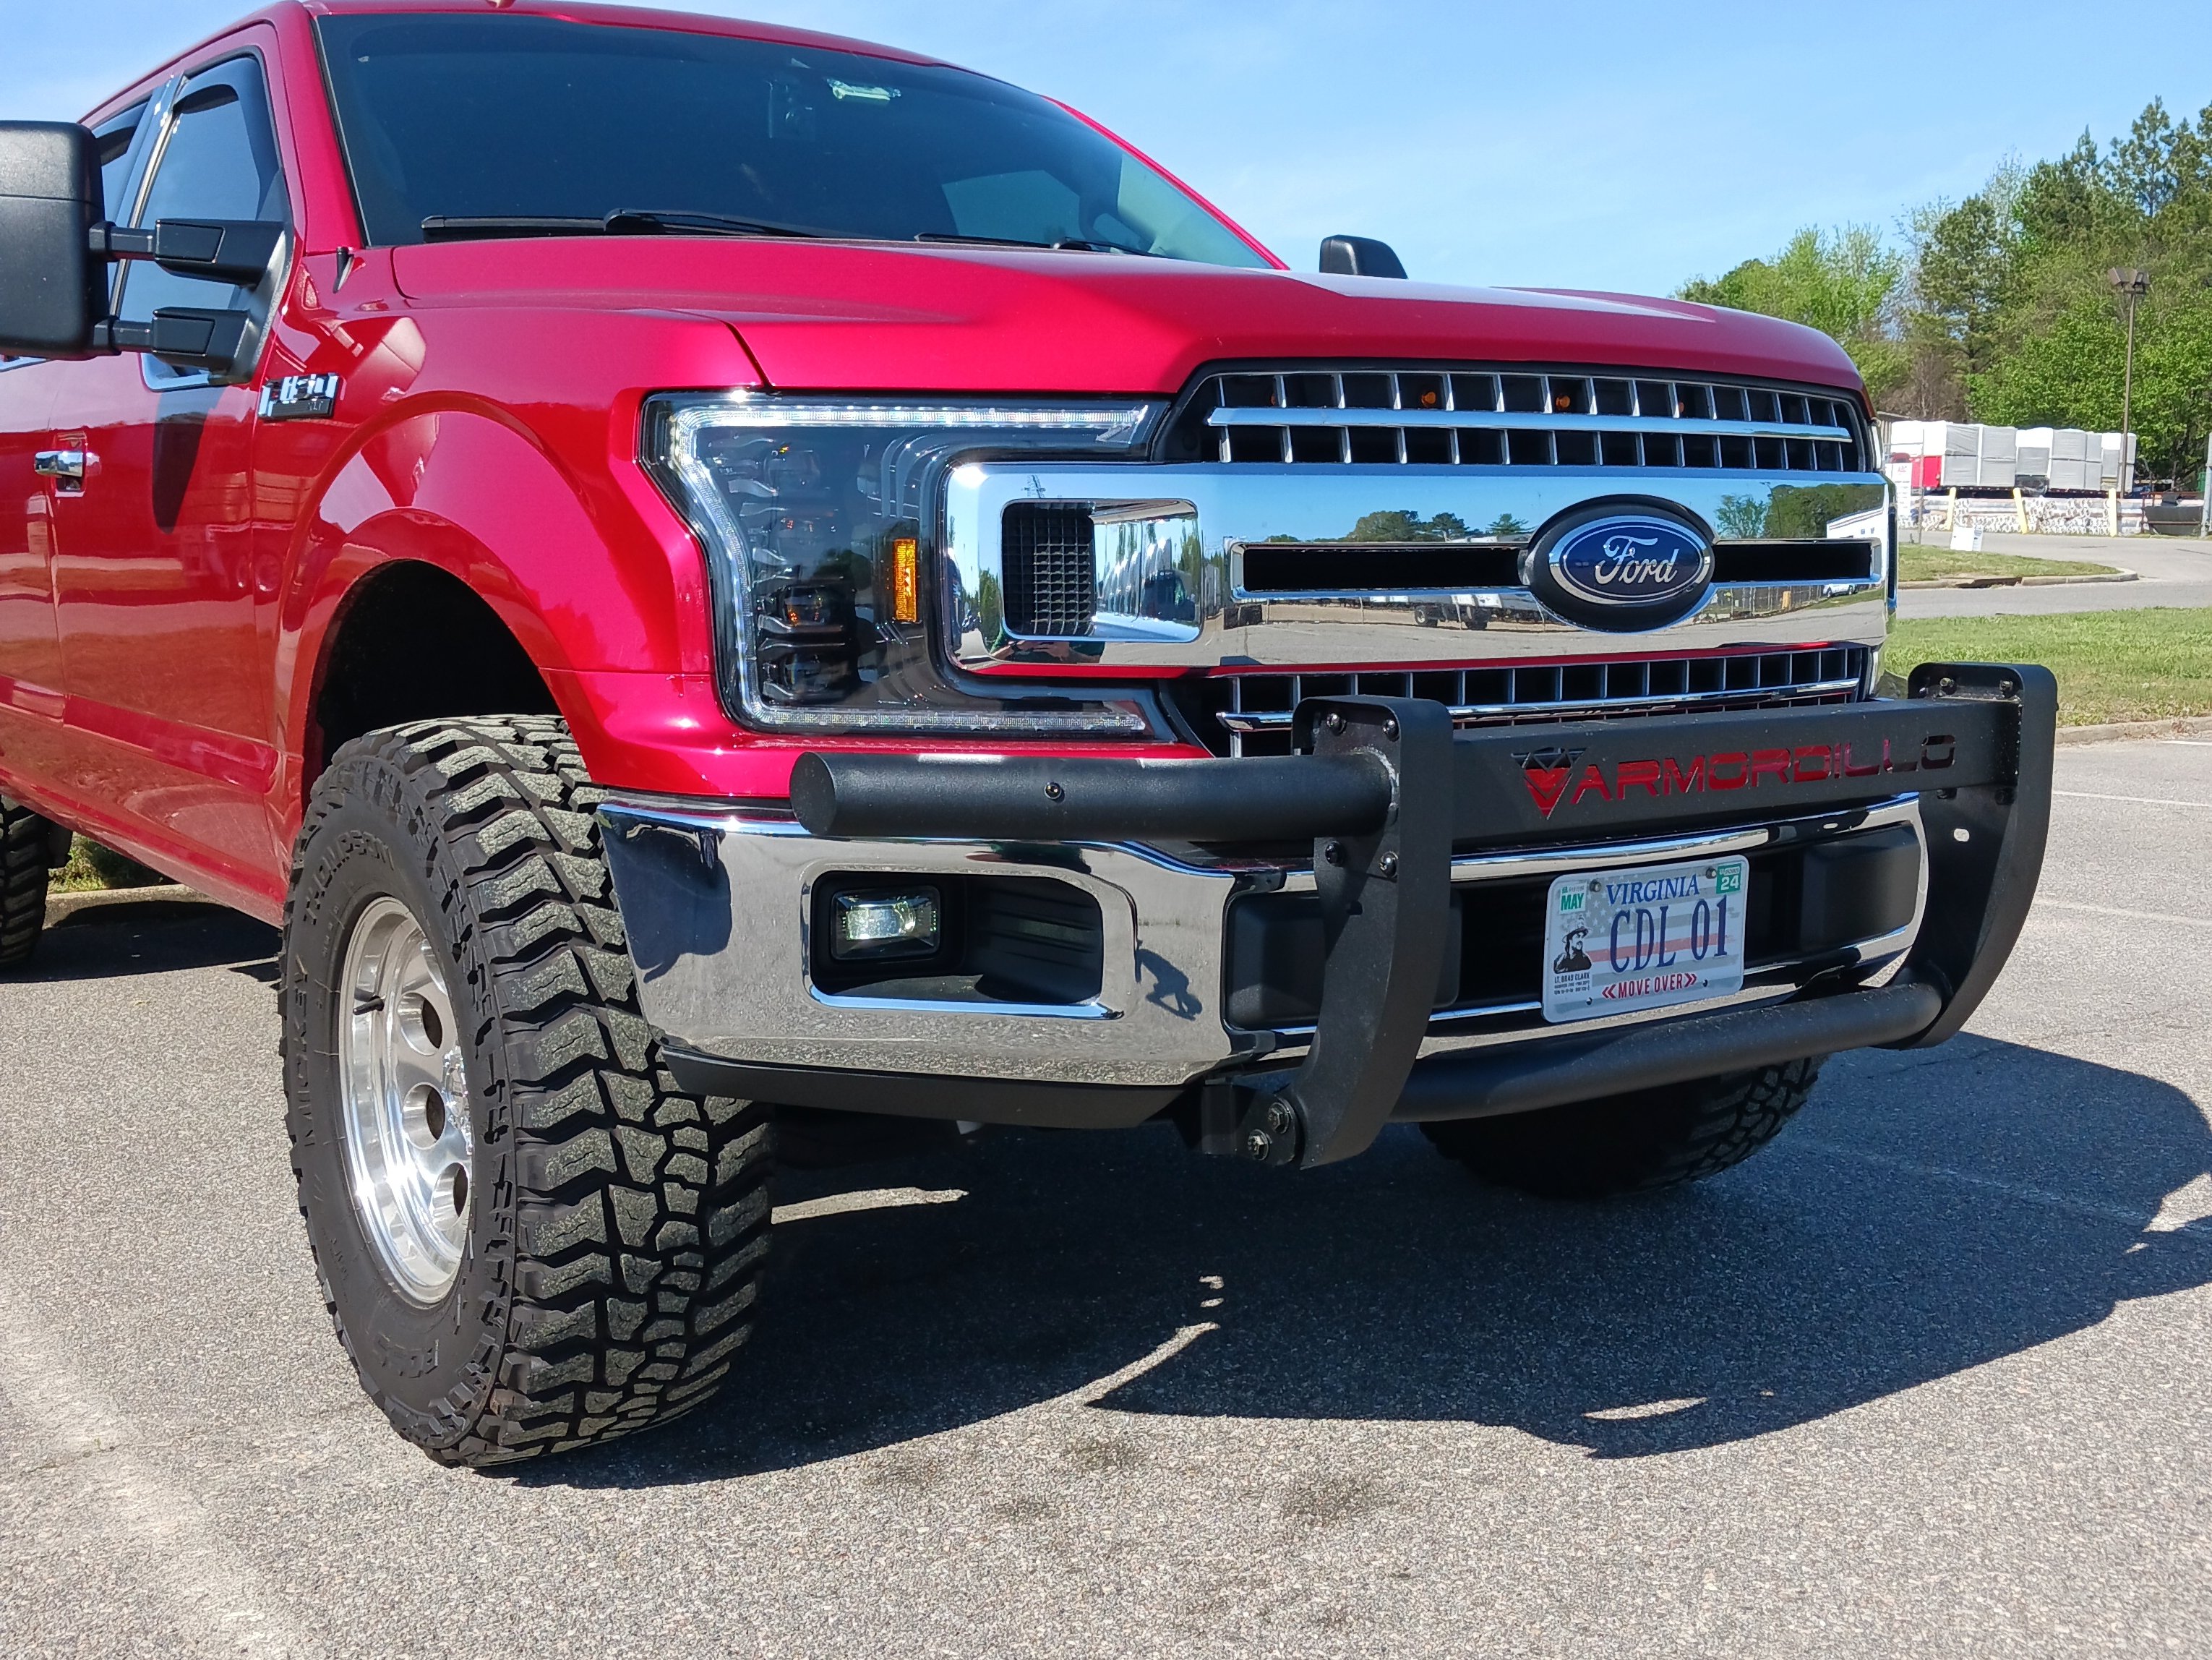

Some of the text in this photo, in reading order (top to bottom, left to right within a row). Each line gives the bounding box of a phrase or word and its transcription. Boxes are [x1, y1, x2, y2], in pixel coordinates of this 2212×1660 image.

[1595, 535, 1679, 585] Ford
[1569, 735, 1956, 805] ARMORDILLO
[1606, 874, 1700, 904] VIRGINIA
[1720, 875, 1739, 891] 24
[1561, 893, 1585, 911] MAY
[1610, 905, 1676, 973] CDL
[1618, 973, 1683, 998] MOVE OVER
